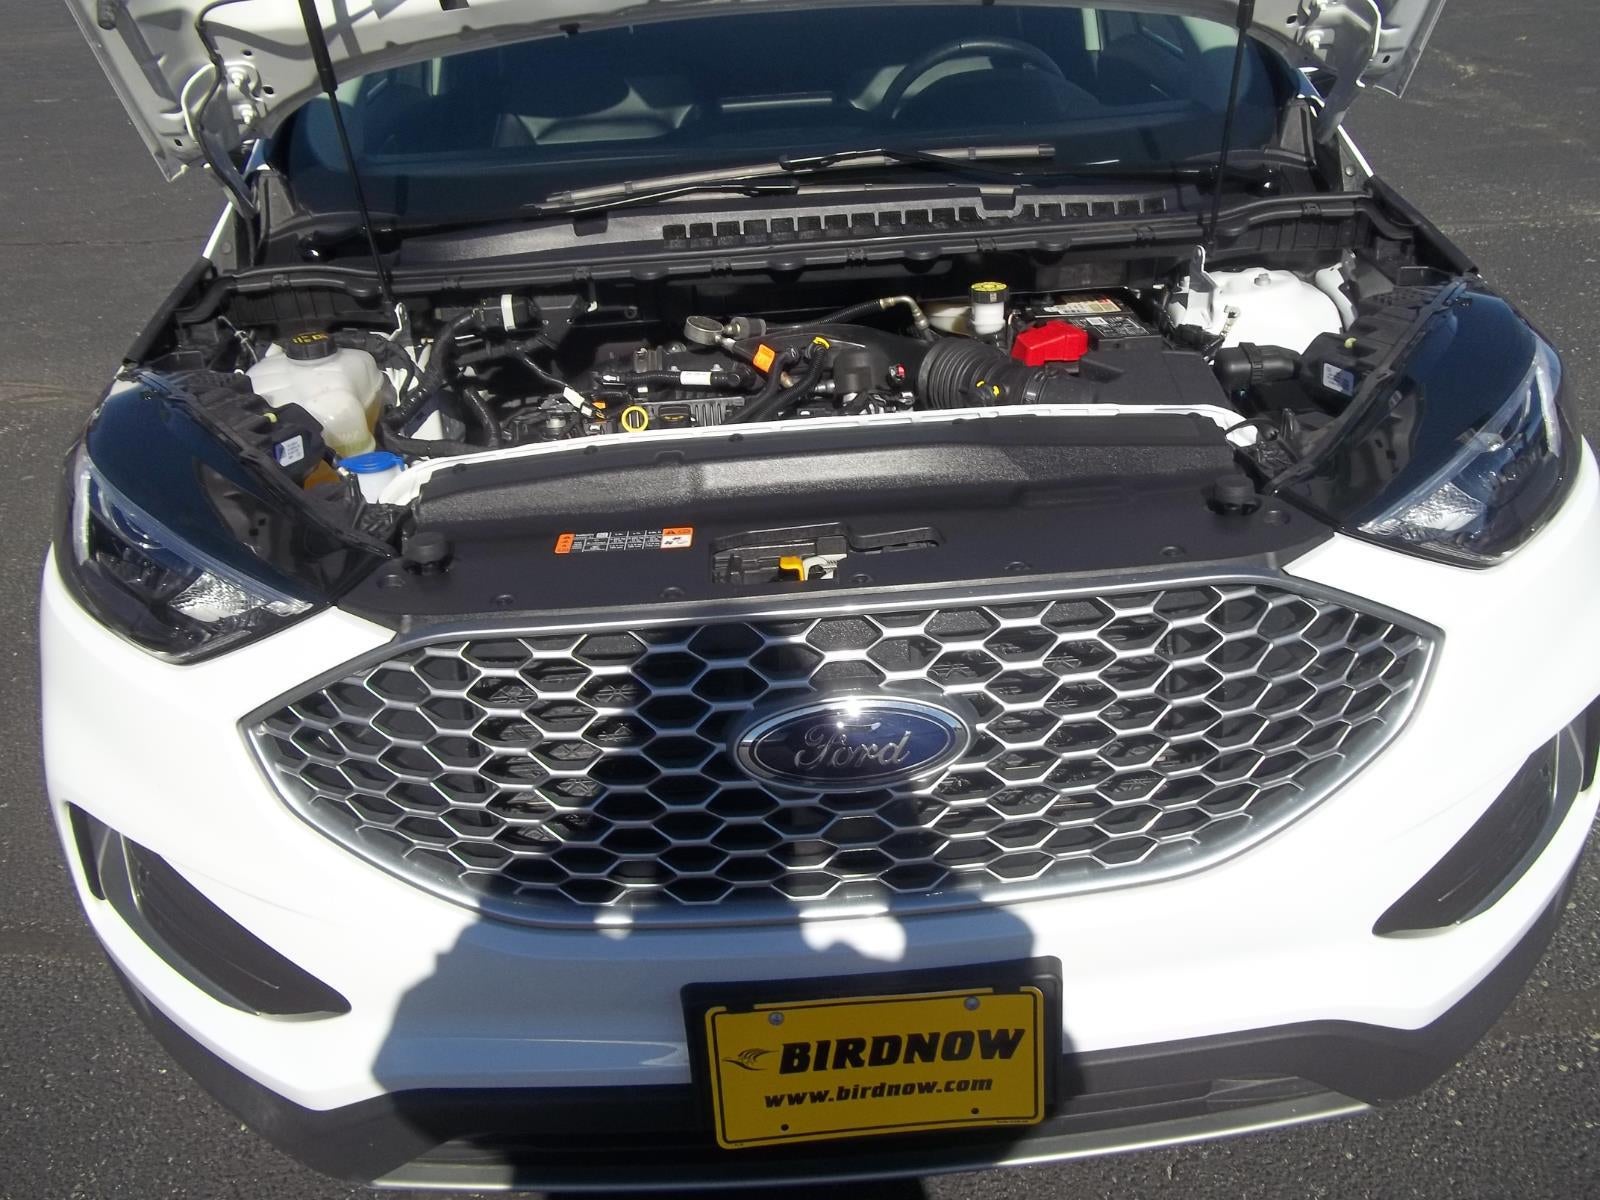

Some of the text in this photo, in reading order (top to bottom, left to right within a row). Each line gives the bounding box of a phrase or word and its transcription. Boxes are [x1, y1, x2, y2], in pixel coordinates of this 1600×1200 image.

[795, 721, 912, 769] Ford
[778, 1028, 1025, 1075] BIRDNOW
[764, 1077, 993, 1108] www.birdnow.com
